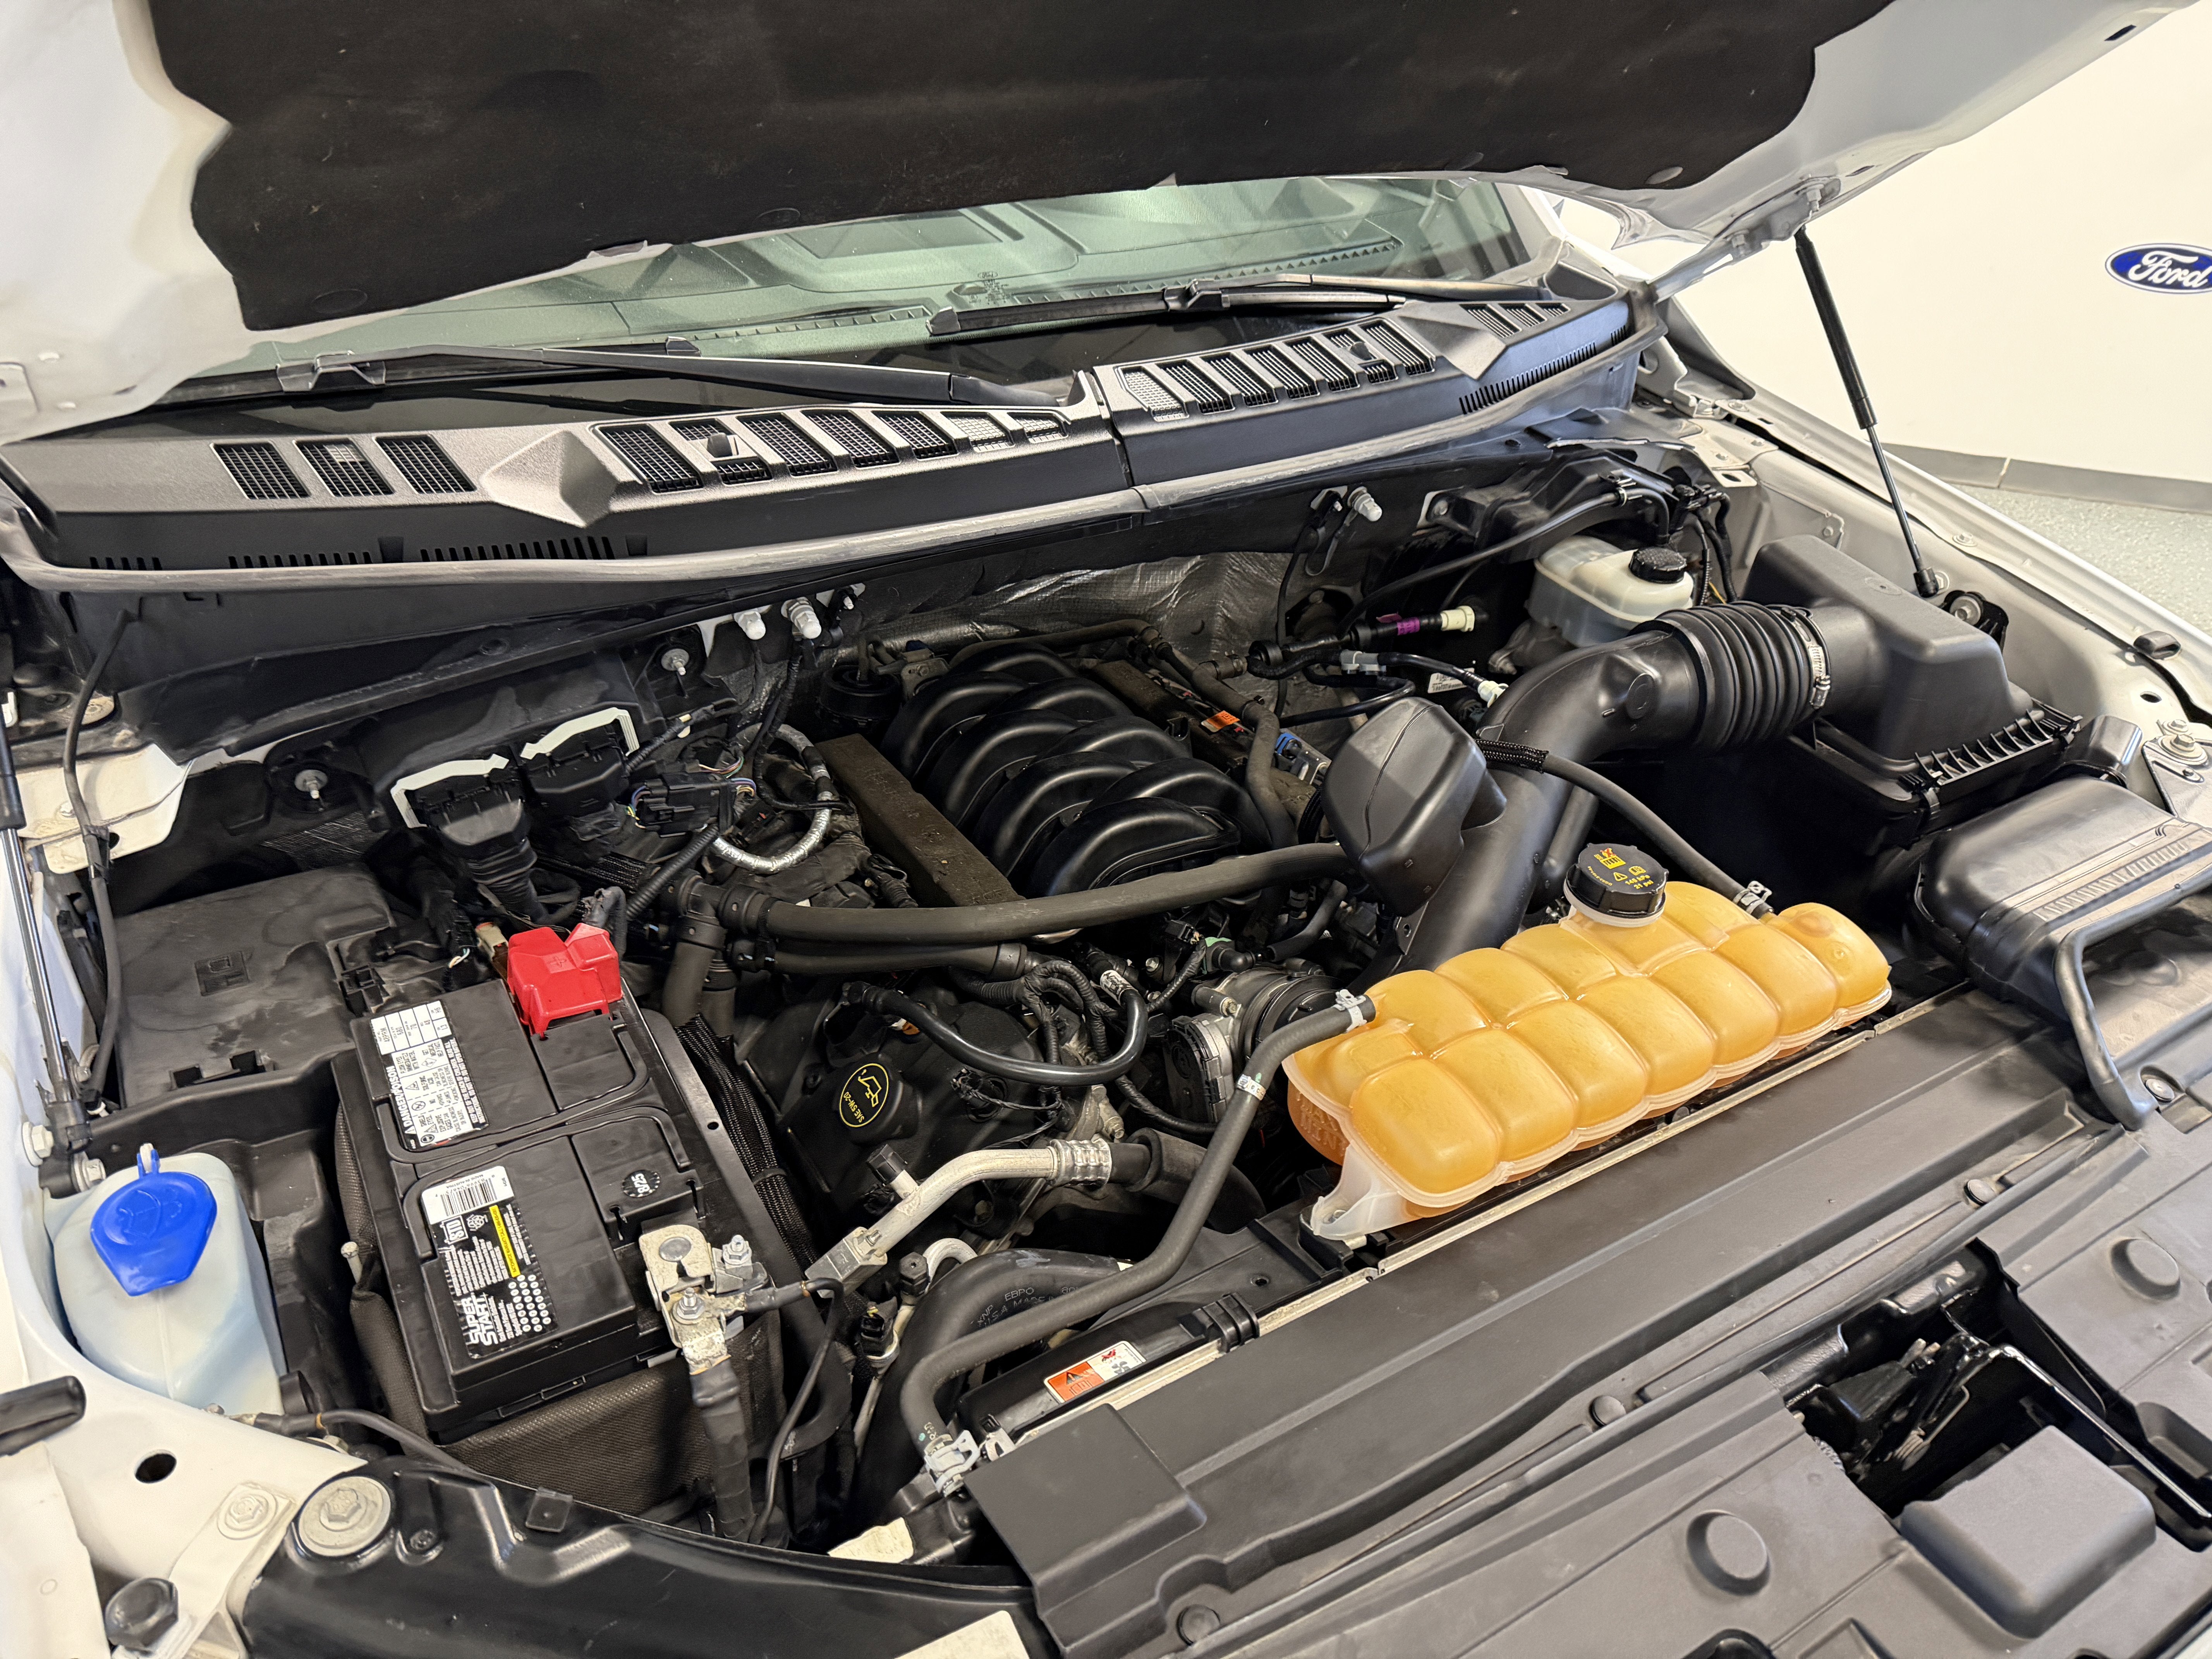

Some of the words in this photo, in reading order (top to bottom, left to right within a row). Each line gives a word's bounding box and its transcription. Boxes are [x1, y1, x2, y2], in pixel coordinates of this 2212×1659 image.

[2128, 251, 2212, 288] Ford
[385, 1065, 414, 1127] DANGER/POISON
[843, 1092, 857, 1111] 5W-20
[854, 1109, 865, 1123] SAE
[632, 1173, 650, 1193] 8/25
[446, 1219, 464, 1242] STD
[460, 1298, 483, 1345] SUPER
[471, 1292, 500, 1346] START
